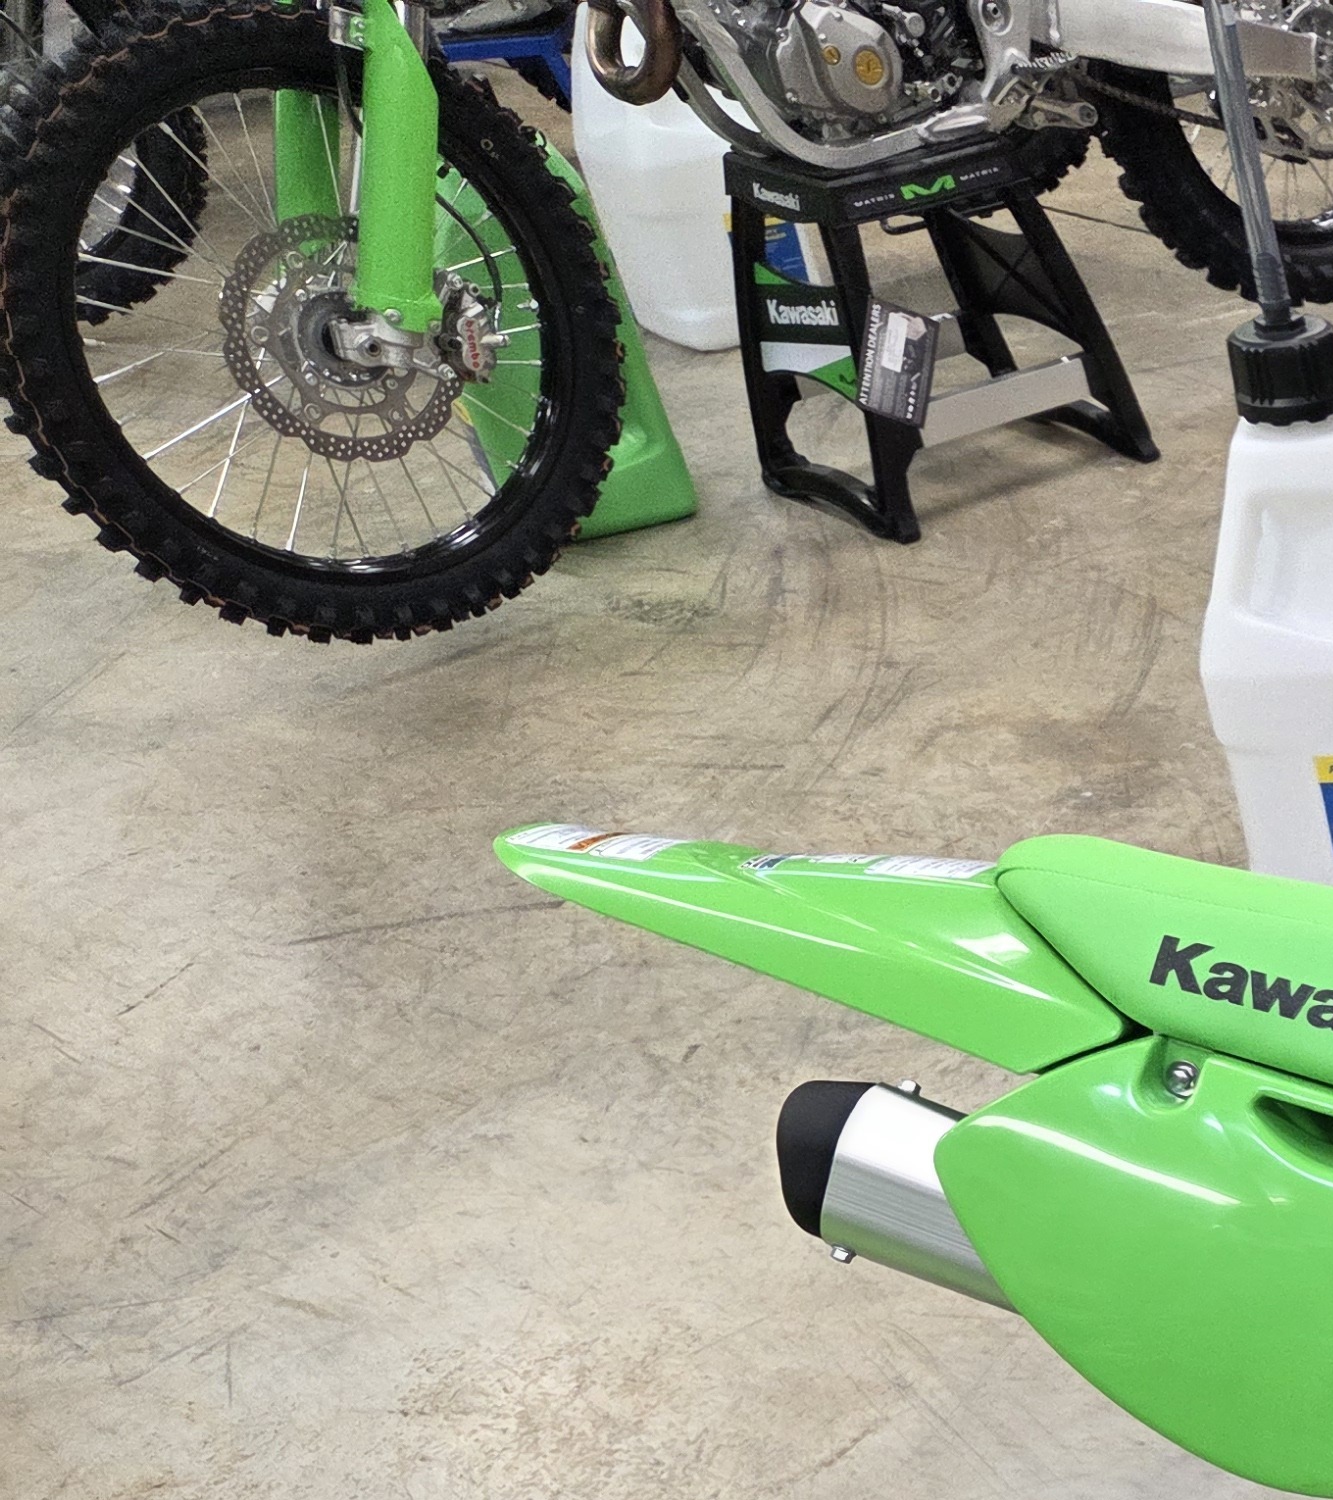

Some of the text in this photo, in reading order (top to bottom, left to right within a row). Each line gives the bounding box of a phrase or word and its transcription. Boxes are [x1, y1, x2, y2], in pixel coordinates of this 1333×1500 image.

[753, 182, 800, 212] Kawasaki
[766, 299, 839, 326] Kawasaki
[464, 320, 480, 369] brembo
